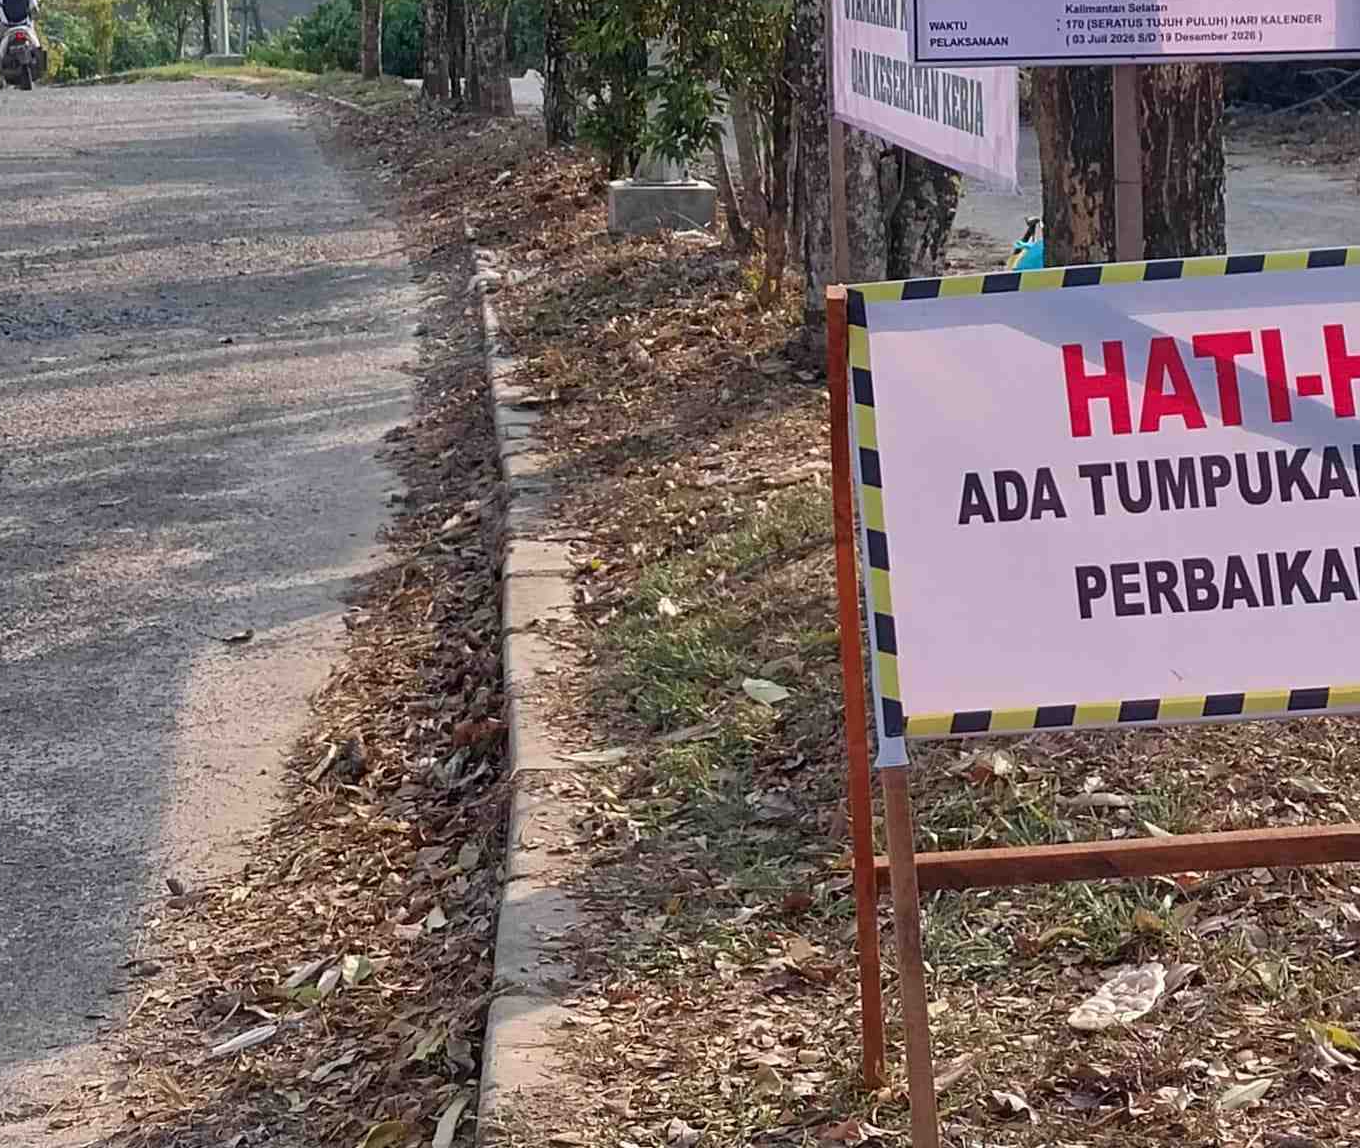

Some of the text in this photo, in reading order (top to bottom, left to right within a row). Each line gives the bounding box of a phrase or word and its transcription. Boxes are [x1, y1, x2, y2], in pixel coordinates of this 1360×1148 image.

[1065, 3, 1168, 14] Kalimantan Selatan
[929, 21, 968, 31] WAKTU
[1066, 19, 1085, 29] 170
[1087, 18, 1143, 31] (SERATUS
[1146, 17, 1183, 28] TUJUH
[1186, 16, 1228, 28] PULUH)
[1230, 15, 1258, 26] HARI
[1261, 14, 1322, 25] KALENDER
[929, 37, 1009, 47] PELAKSANAAN
[1072, 34, 1085, 44] 03
[1087, 34, 1107, 44] Juli
[1110, 33, 1135, 43] 2026
[1138, 32, 1157, 43] S/D
[1175, 31, 1228, 42] Desember
[851, 47, 985, 137] DAN KESEHATAN KERJA
[958, 467, 1067, 525] ADA
